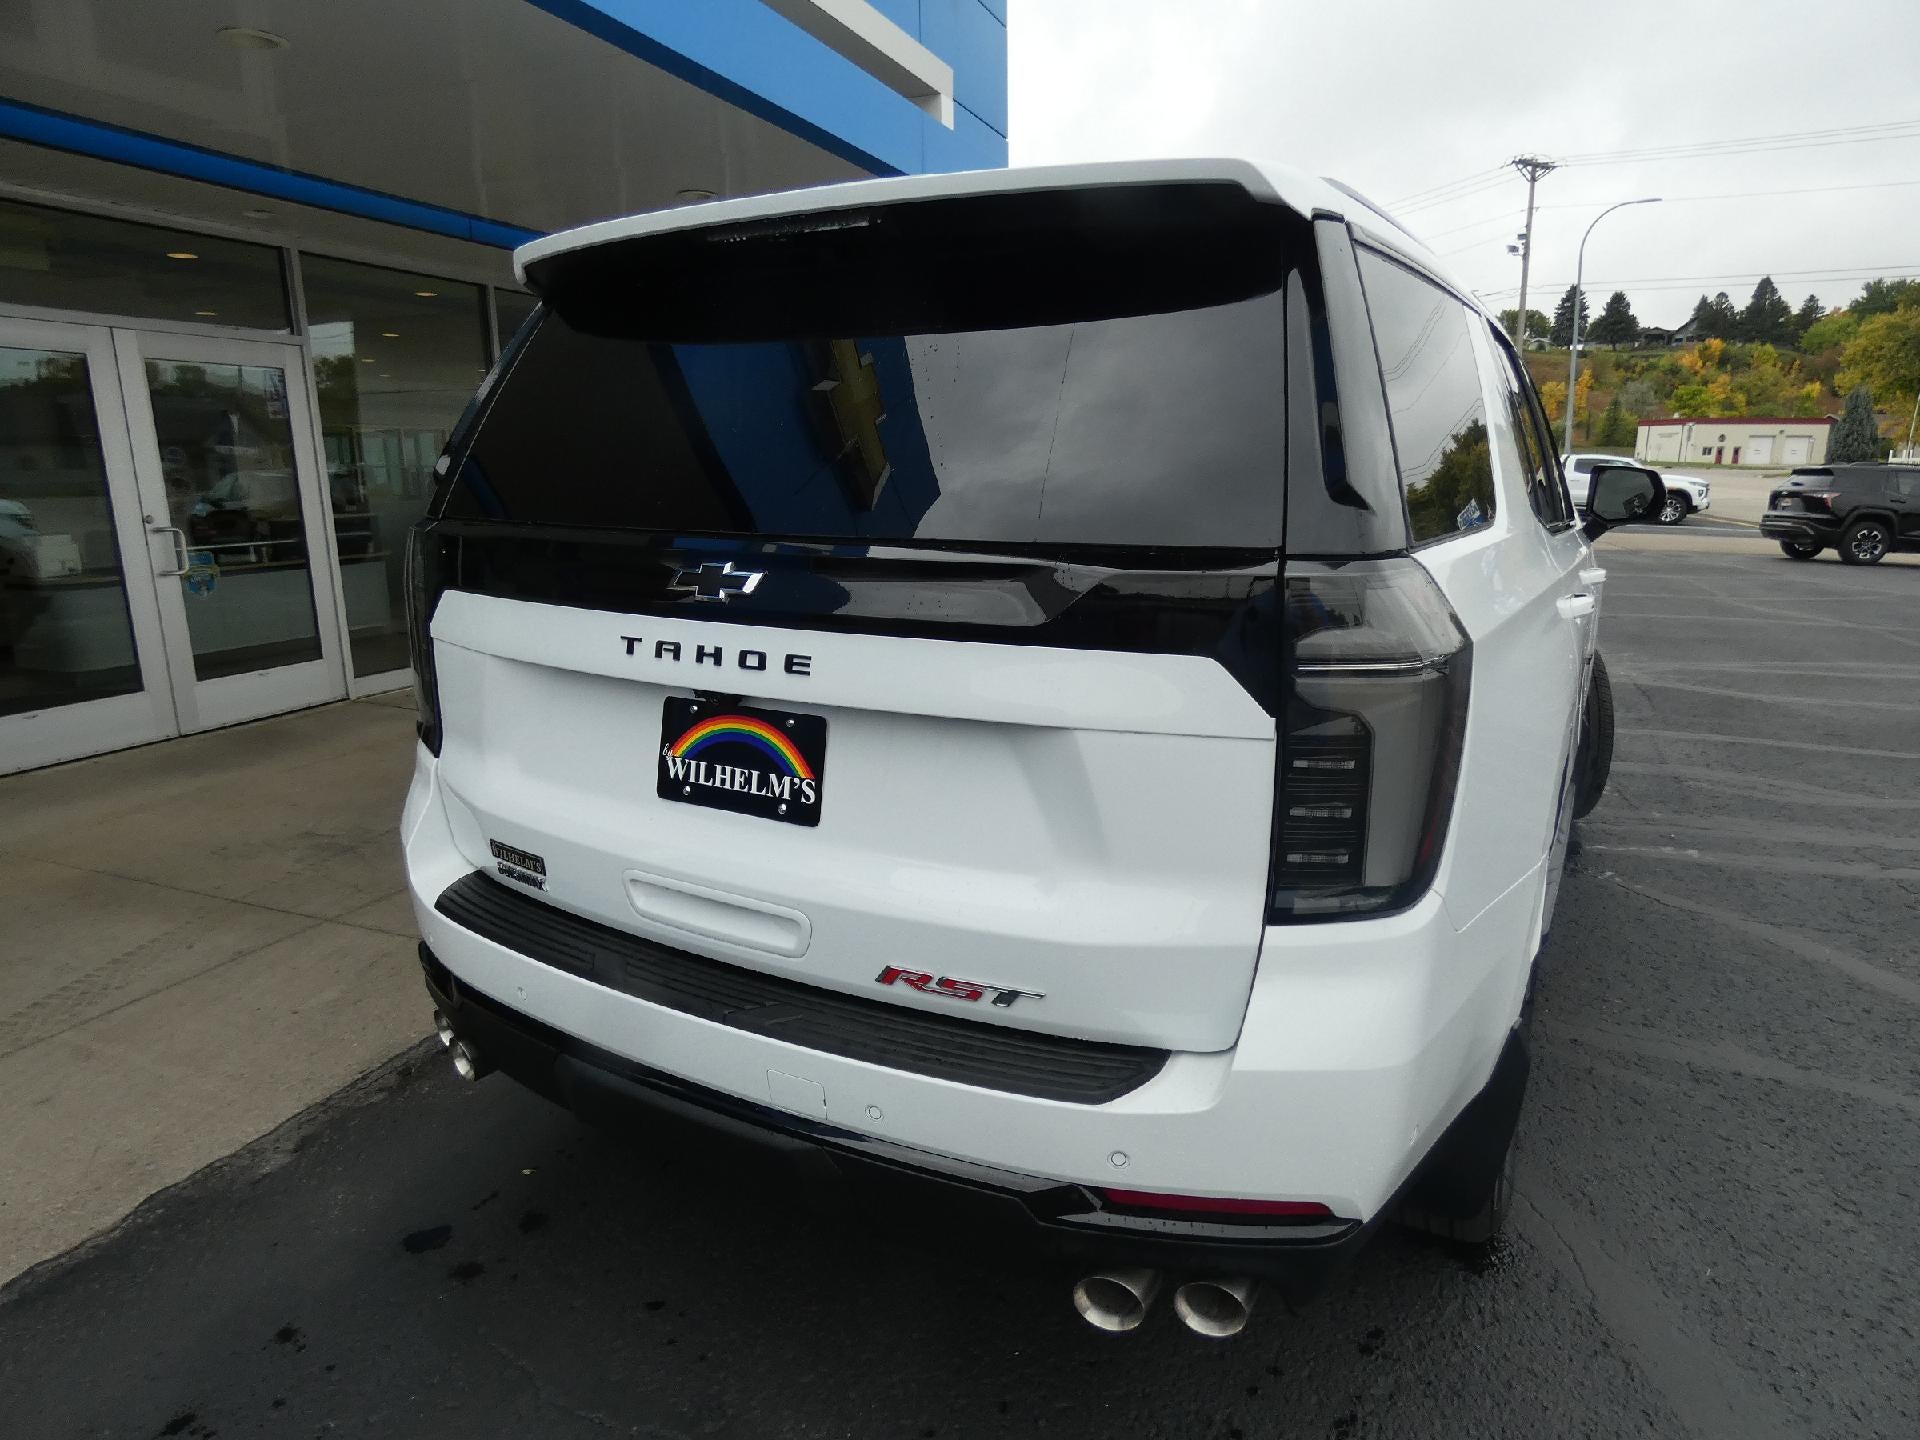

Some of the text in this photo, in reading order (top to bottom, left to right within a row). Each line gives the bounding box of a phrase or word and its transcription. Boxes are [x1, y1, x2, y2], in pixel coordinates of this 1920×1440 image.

[620, 635, 812, 676] TAHOE
[666, 756, 816, 804] WILHELM'S
[875, 965, 1047, 1007] RST
